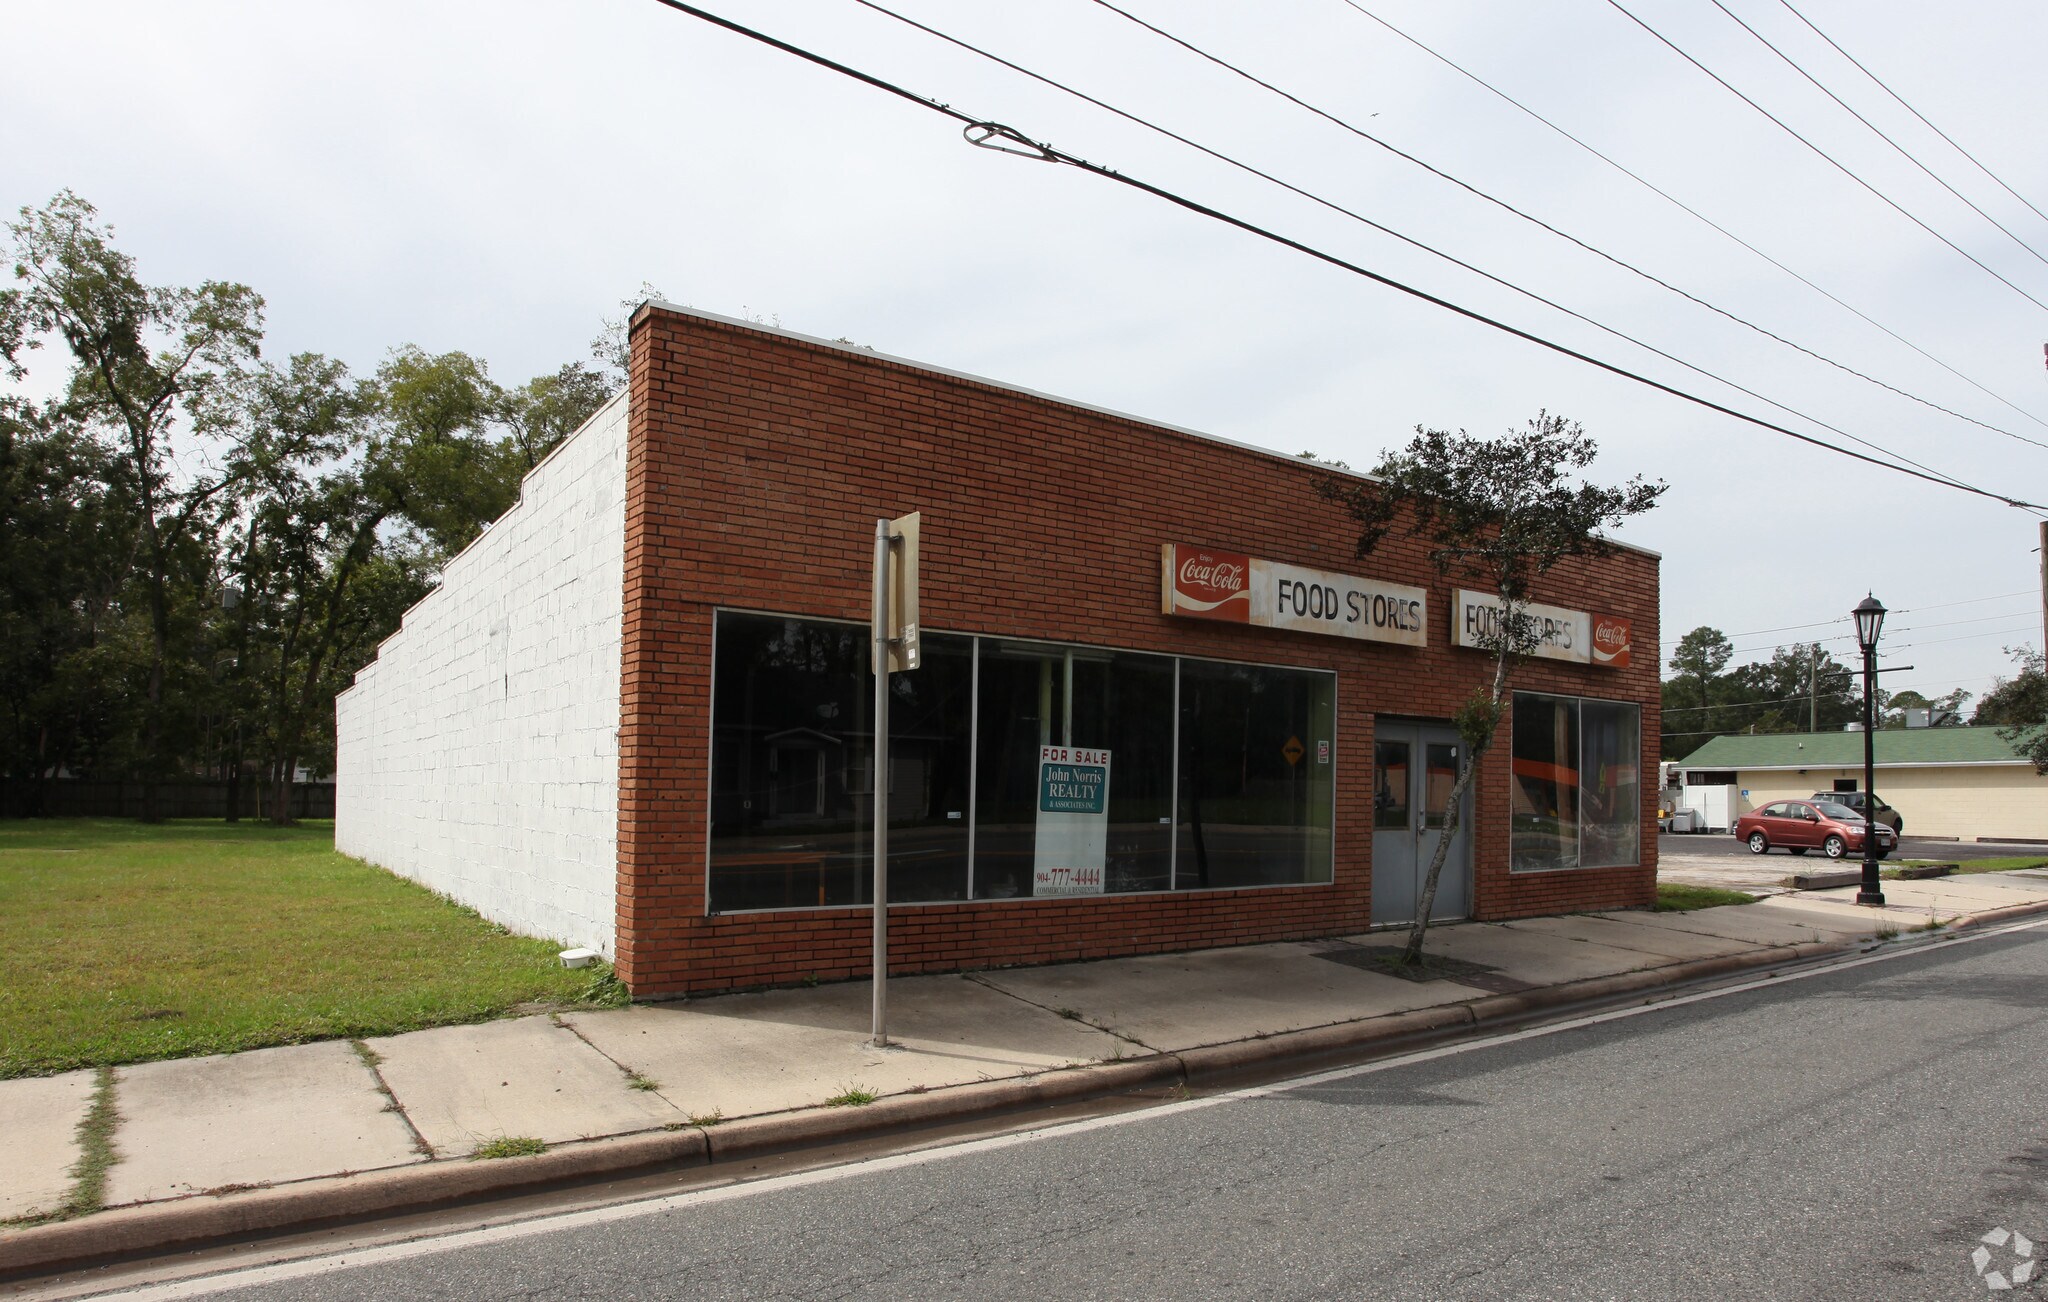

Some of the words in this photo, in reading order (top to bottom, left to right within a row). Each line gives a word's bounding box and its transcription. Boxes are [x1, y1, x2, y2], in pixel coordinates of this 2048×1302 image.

[1199, 553, 1214, 563] Enjoy
[1180, 557, 1244, 591] Coca-Cola
[1278, 579, 1339, 620] FOOD
[1346, 590, 1421, 633] STORES
[1512, 612, 1572, 649] TORES
[1043, 748, 1068, 761] FOR
[1075, 751, 1107, 764] SALE
[1046, 766, 1069, 782] John
[1072, 768, 1102, 783] Norris
[1049, 783, 1097, 799] REALTY
[1055, 800, 1085, 809] ASSOCIATES
[1036, 868, 1100, 886] 904-777-4444
